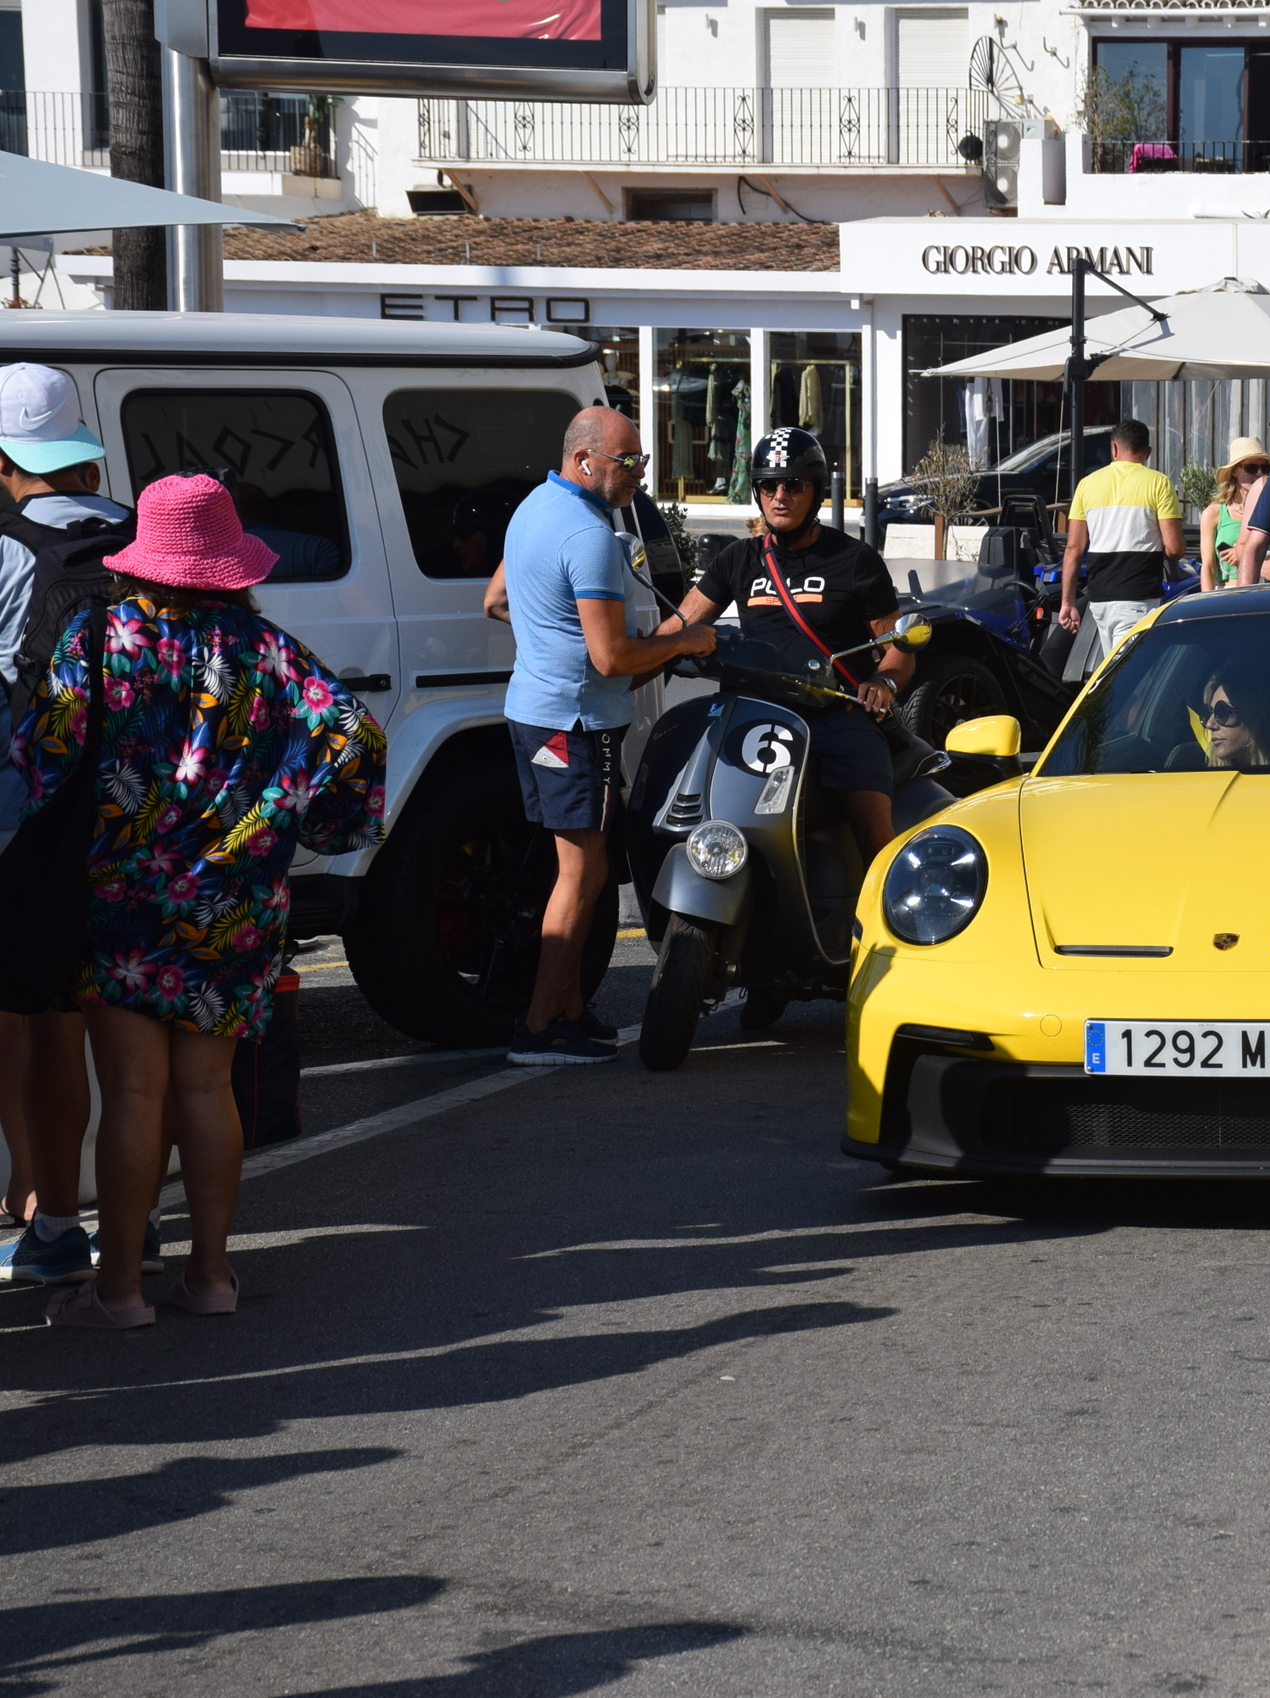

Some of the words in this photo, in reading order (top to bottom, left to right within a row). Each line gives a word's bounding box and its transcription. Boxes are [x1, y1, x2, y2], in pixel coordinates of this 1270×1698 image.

[921, 244, 1037, 275] GIORGIO
[1045, 245, 1155, 275] ARMANI
[380, 293, 590, 323] ETRO
[601, 733, 612, 786] OMMY
[742, 723, 794, 774] 6
[1092, 1053, 1101, 1064] E
[1121, 1029, 1224, 1068] 1292
